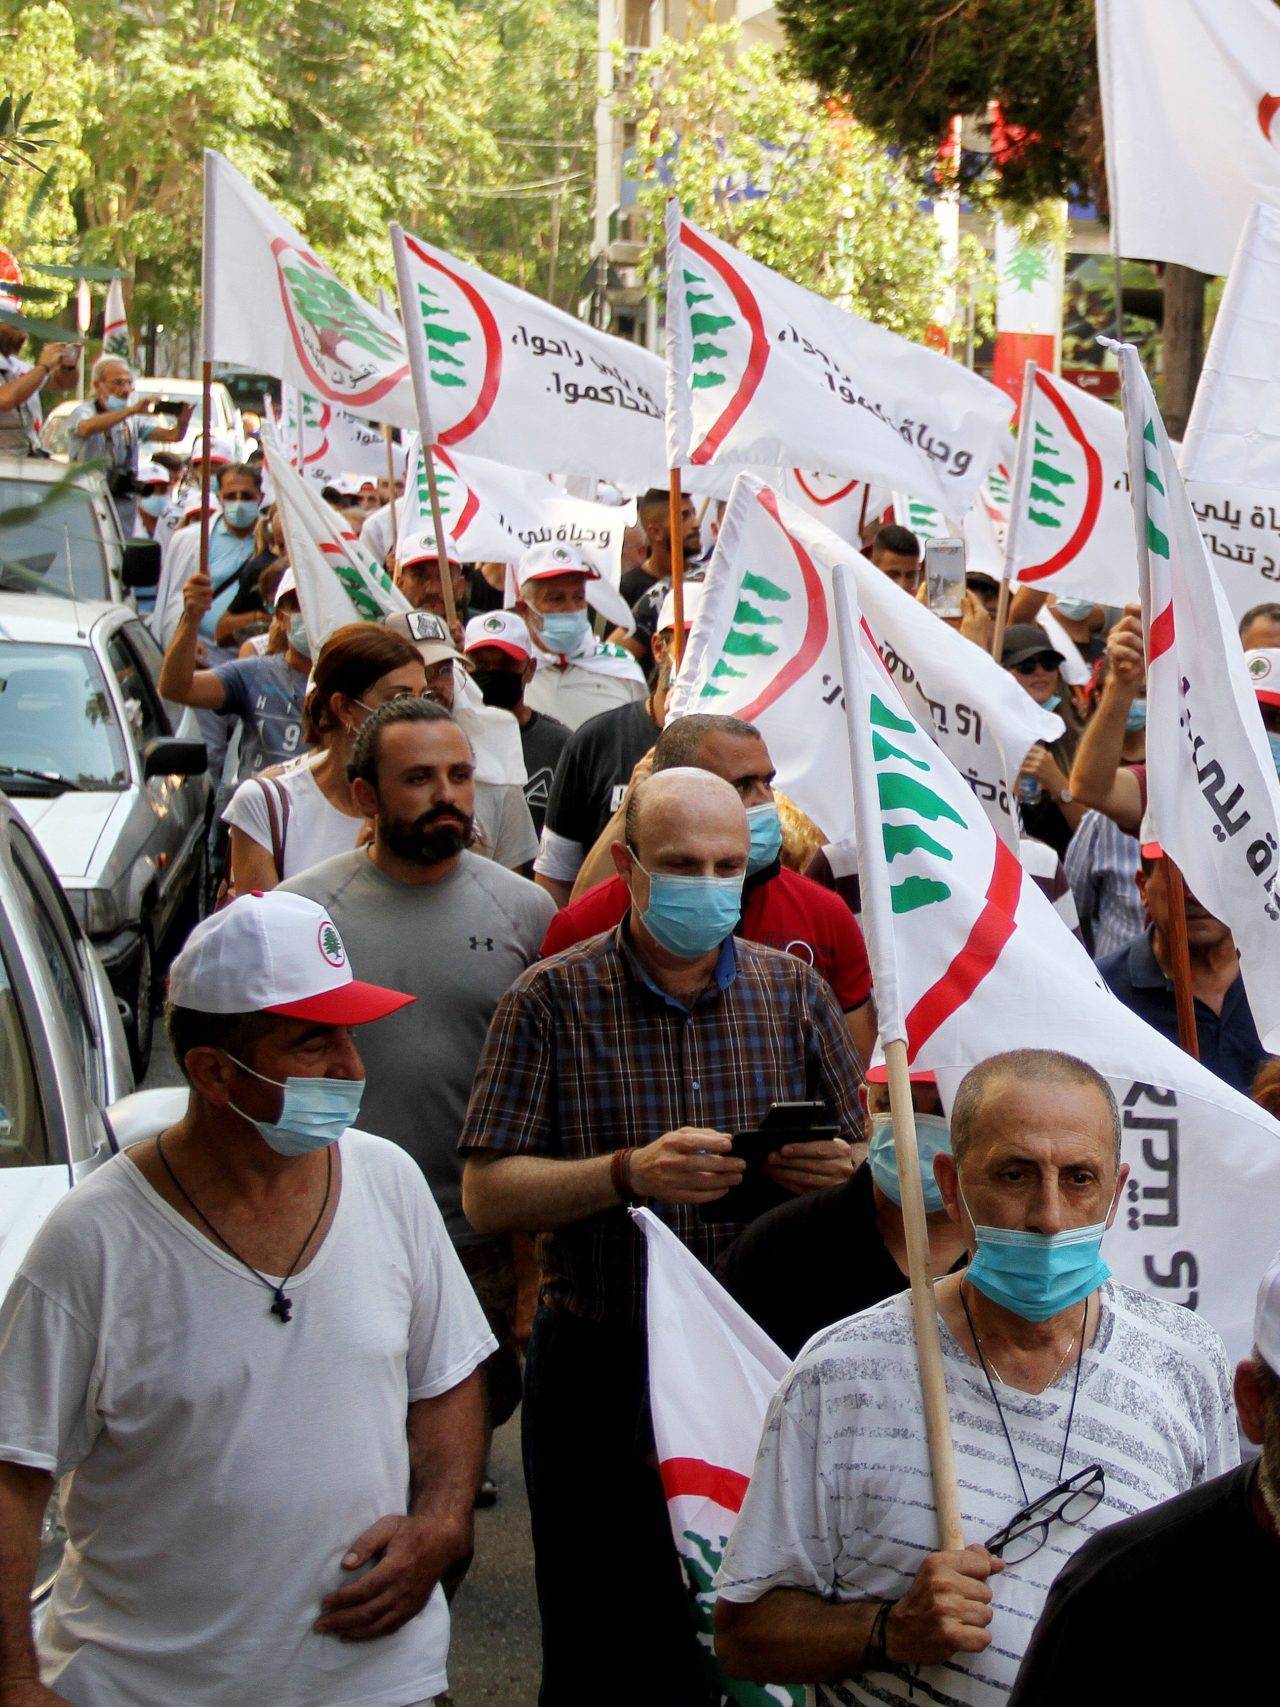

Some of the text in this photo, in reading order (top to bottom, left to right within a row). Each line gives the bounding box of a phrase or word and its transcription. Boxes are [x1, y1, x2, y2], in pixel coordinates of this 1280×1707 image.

[512, 325, 584, 367] راحوا،
[900, 418, 973, 477] وحياة
[1191, 500, 1241, 530] يلي
[556, 523, 611, 549] وحياة
[1202, 532, 1256, 565] تتحا
